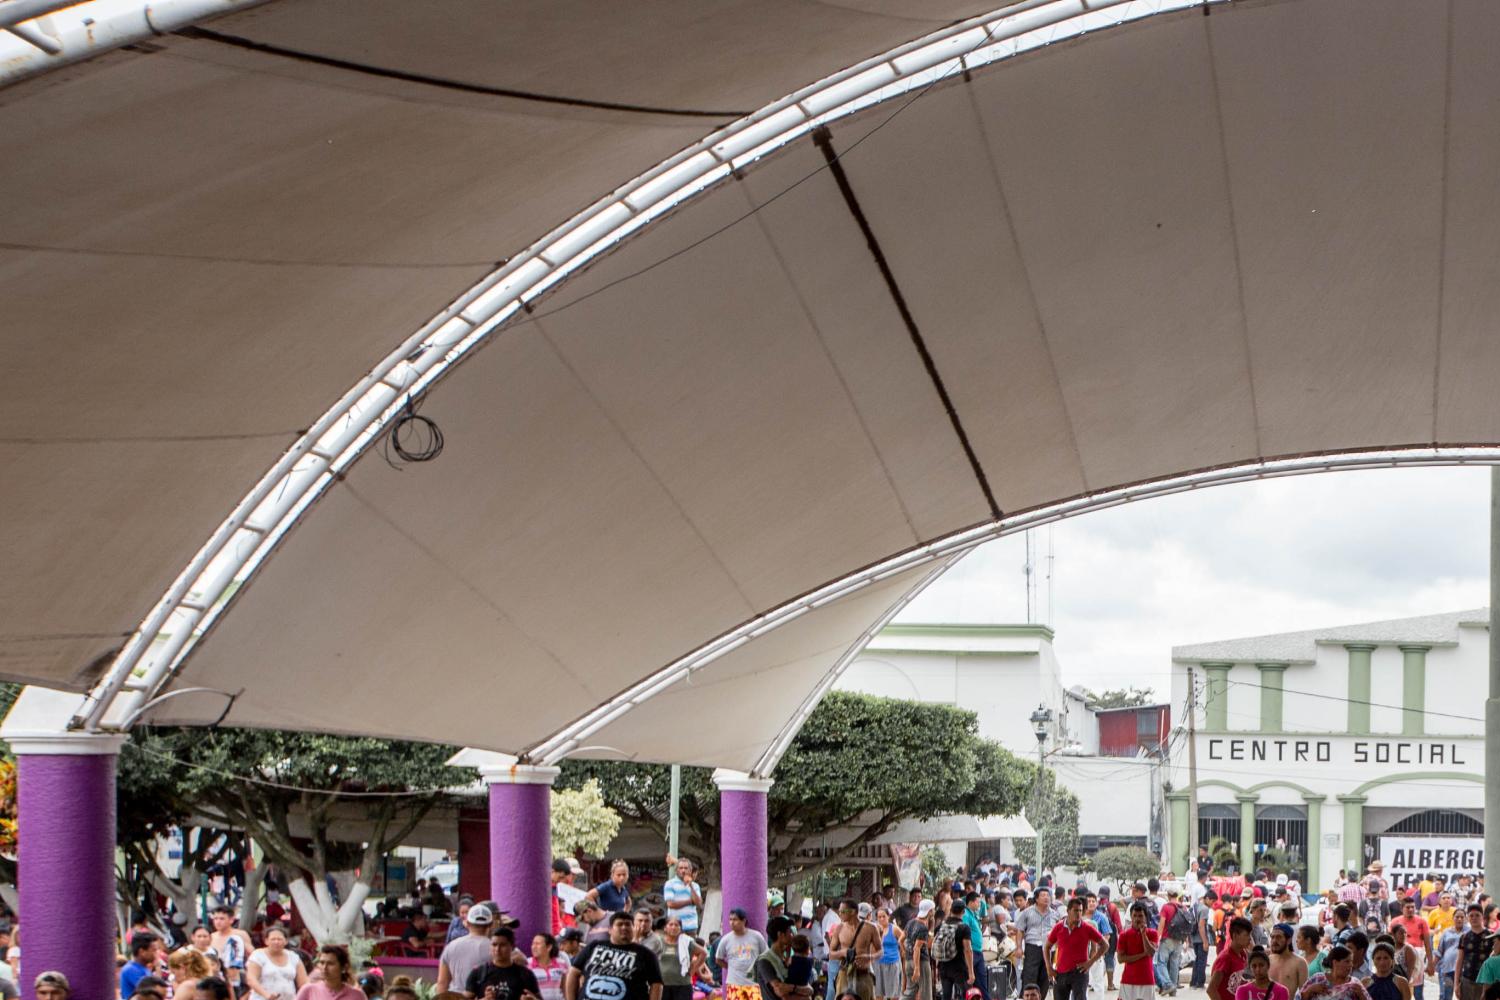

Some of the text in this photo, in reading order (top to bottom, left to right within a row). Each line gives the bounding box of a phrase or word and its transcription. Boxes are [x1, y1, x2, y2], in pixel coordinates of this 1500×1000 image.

[1209, 739, 1330, 762] CENTRO
[1354, 742, 1465, 764] SOCIAL
[1392, 849, 1485, 869] ALBERGU
